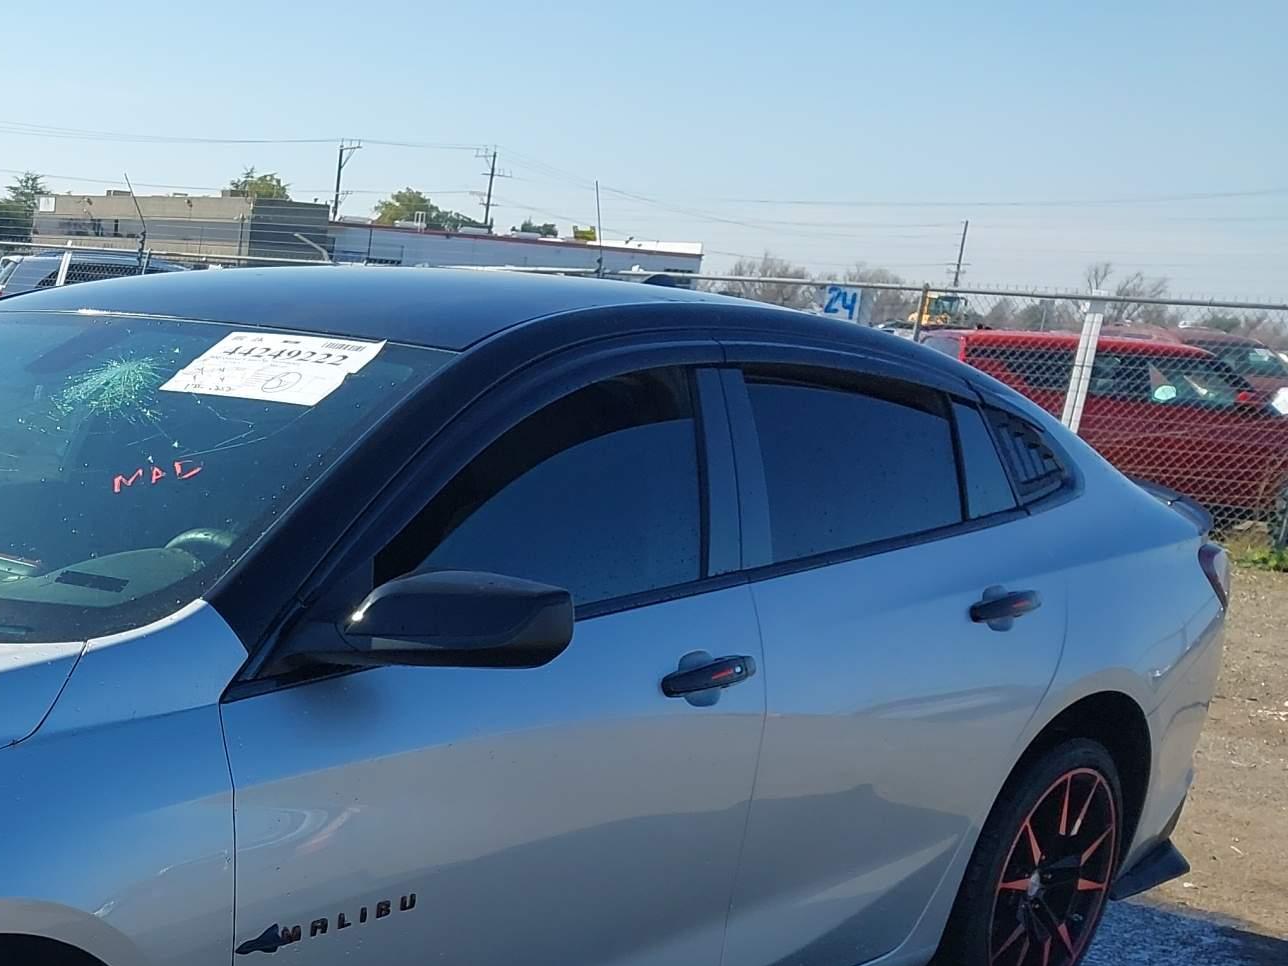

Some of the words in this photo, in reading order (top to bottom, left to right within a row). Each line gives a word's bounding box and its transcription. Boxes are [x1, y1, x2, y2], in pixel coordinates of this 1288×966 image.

[823, 286, 857, 320] 24
[223, 345, 349, 366] 44249222
[280, 893, 417, 942] MALIBU
